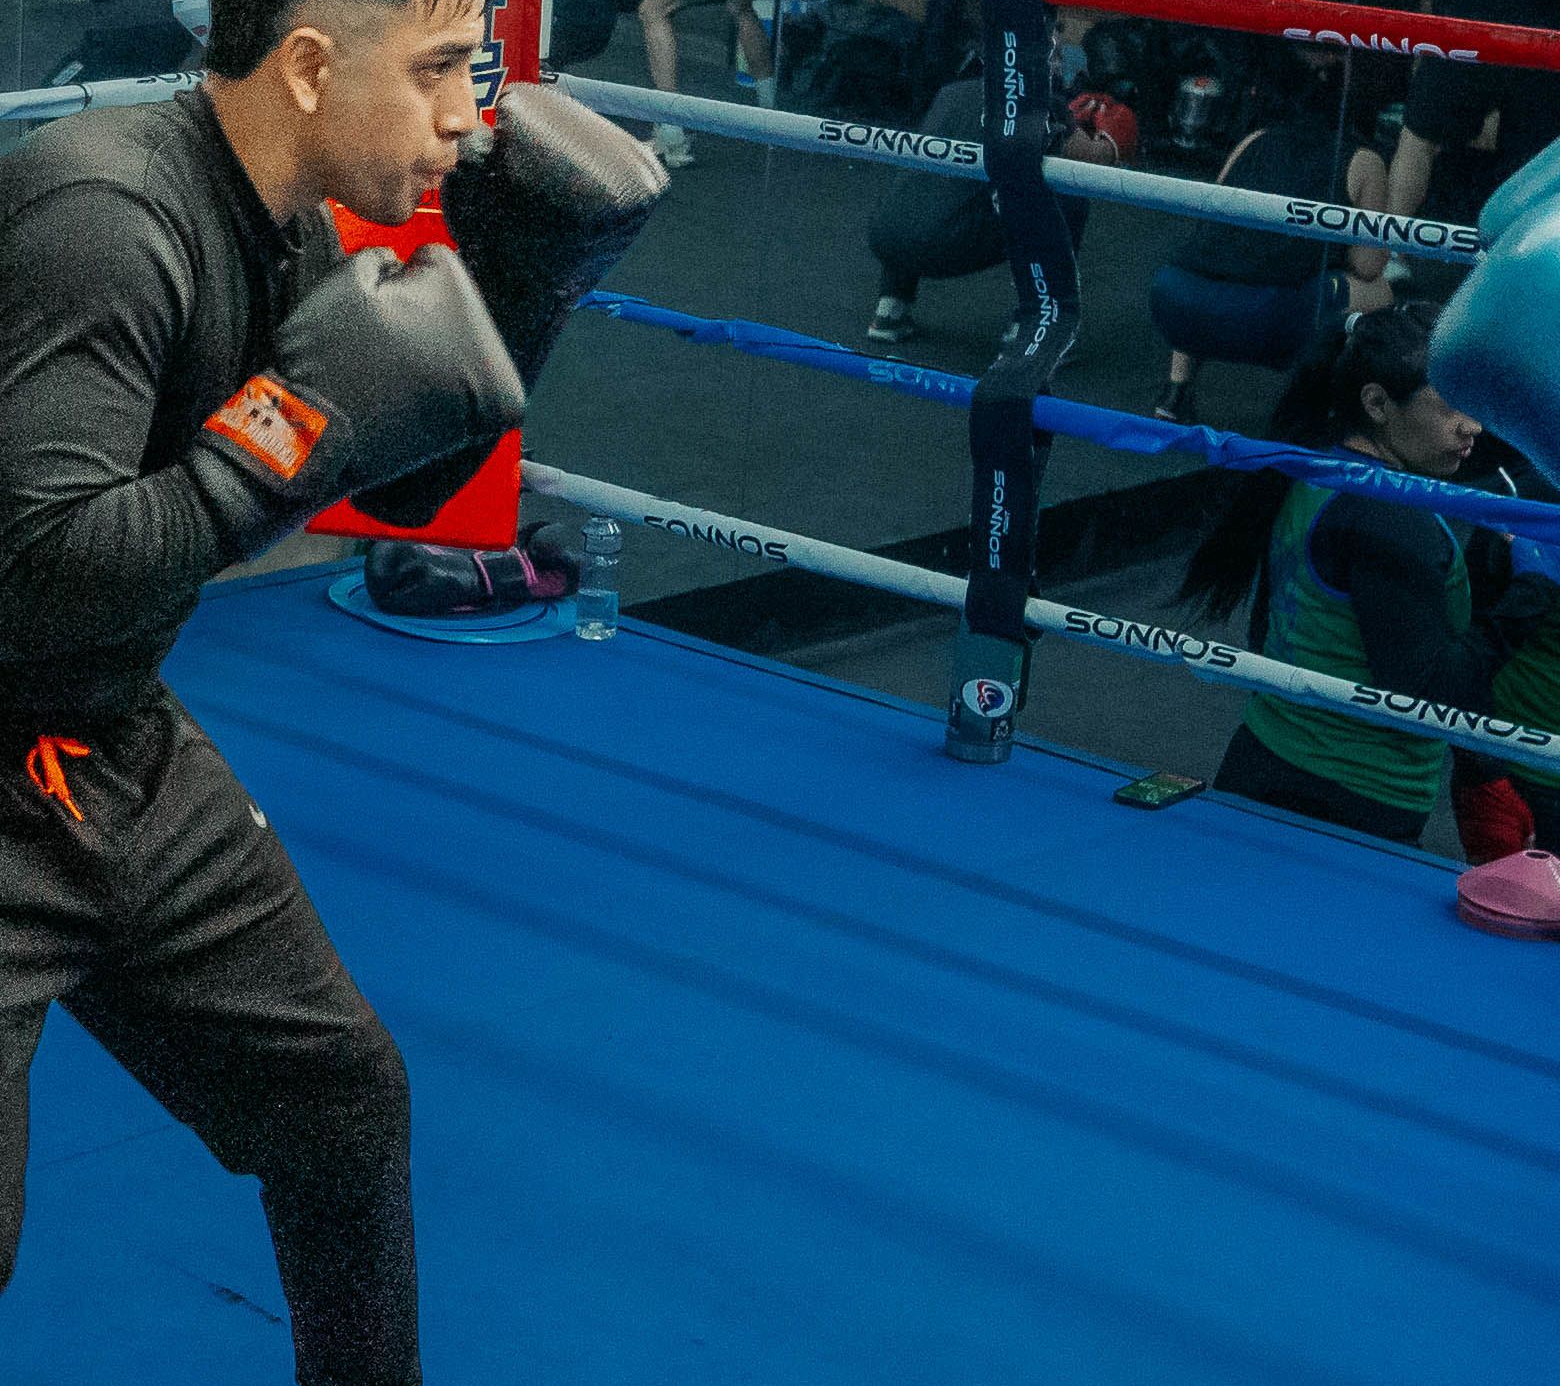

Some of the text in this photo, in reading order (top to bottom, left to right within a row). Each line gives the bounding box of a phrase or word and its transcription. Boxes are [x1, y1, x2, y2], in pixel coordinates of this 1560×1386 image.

[1003, 30, 1017, 138] SONNOS
[818, 120, 979, 165] SONNOS
[1285, 201, 1481, 253] SONNOS
[1025, 262, 1053, 357] SONNOS
[644, 515, 789, 564] SONNOS
[990, 469, 1005, 570] SONNOS
[1064, 610, 1238, 669] SONNOS
[1351, 682, 1553, 747] SONNOS
